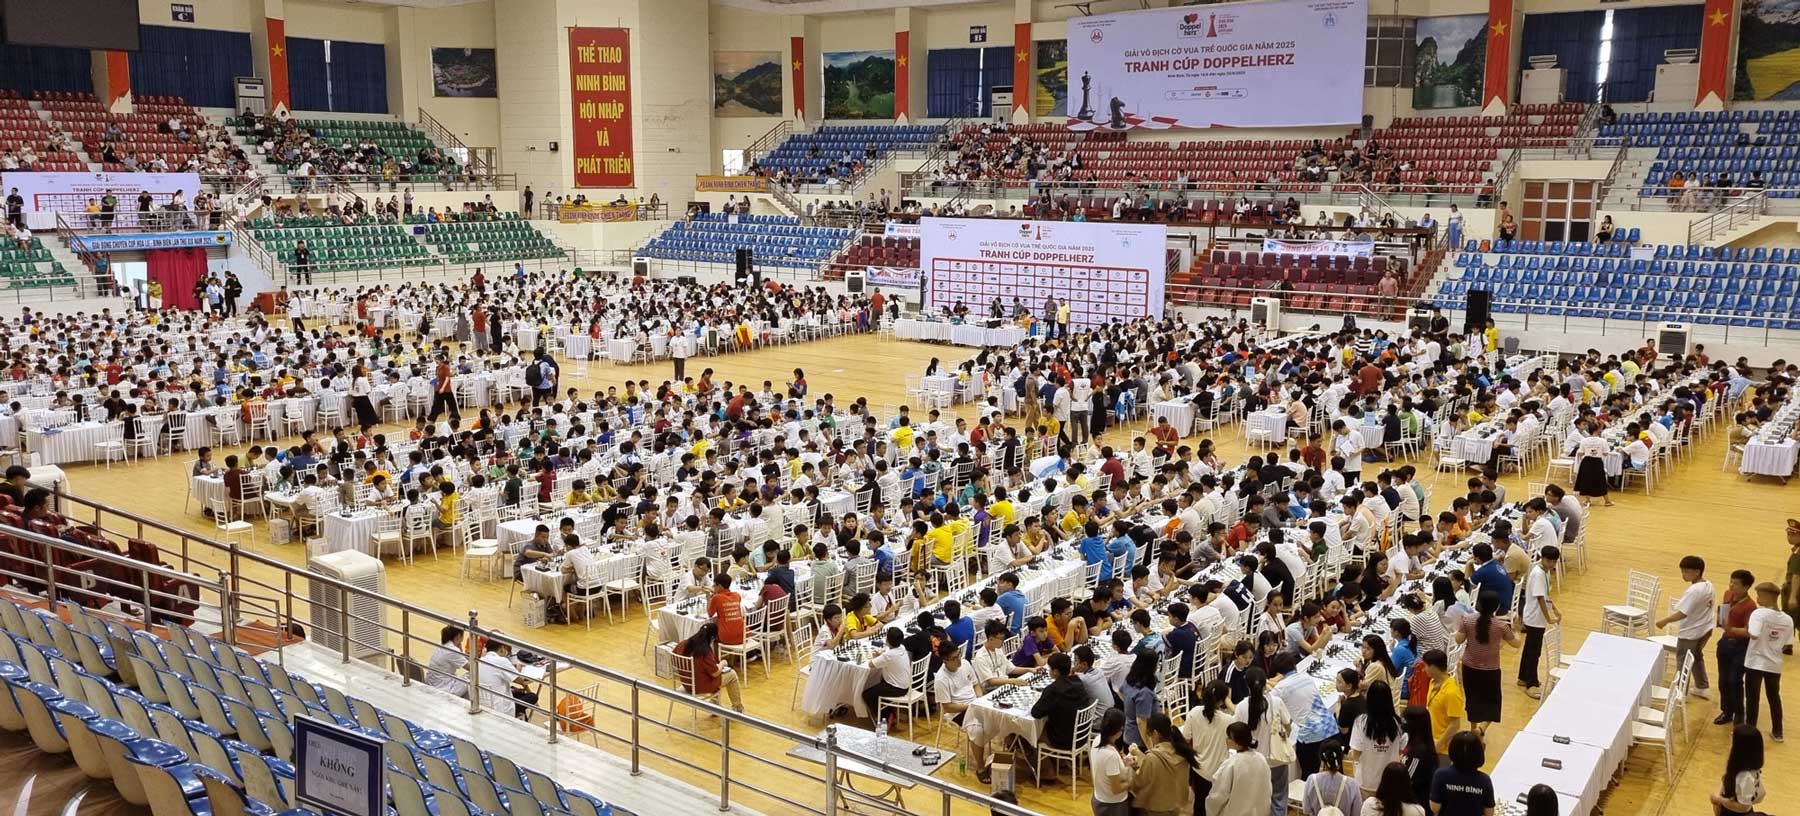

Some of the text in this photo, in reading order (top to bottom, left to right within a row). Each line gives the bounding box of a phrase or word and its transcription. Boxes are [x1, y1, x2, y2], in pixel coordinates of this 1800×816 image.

[578, 40, 622, 63] THỂ THAO
[1125, 54, 1294, 72] TRANH CÚP DOPPELHERZ
[576, 72, 626, 92] NINH BÌNH
[580, 99, 624, 122] HỘI NHẬP
[597, 128, 610, 146] VÀ
[577, 152, 631, 174] PHÁT TRIỂN
[980, 249, 1094, 263] TRANH CÚP DOPPELHERZ
[177, 584, 191, 604] A
[320, 755, 354, 777] KHÔNG
[1446, 783, 1464, 792] NINH
